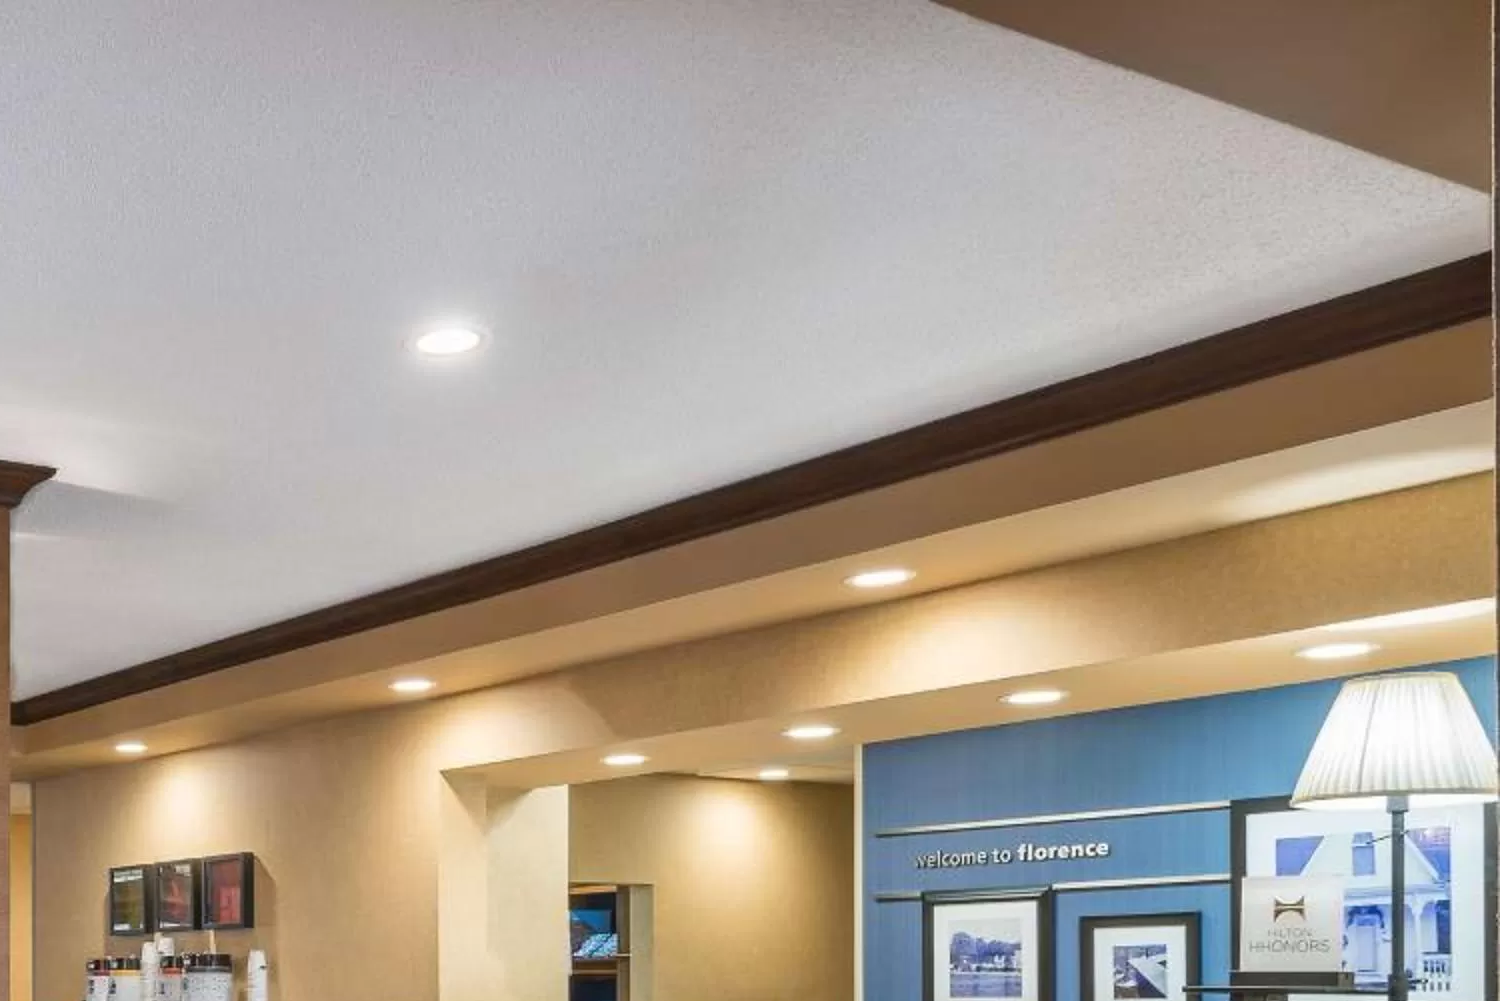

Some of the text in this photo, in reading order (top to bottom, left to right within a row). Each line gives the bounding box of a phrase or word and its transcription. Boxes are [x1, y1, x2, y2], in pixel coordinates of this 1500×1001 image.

[916, 842, 1110, 868] welcome to florence
[1267, 927, 1313, 938] HILTON
[1248, 939, 1331, 953] HHONORS
